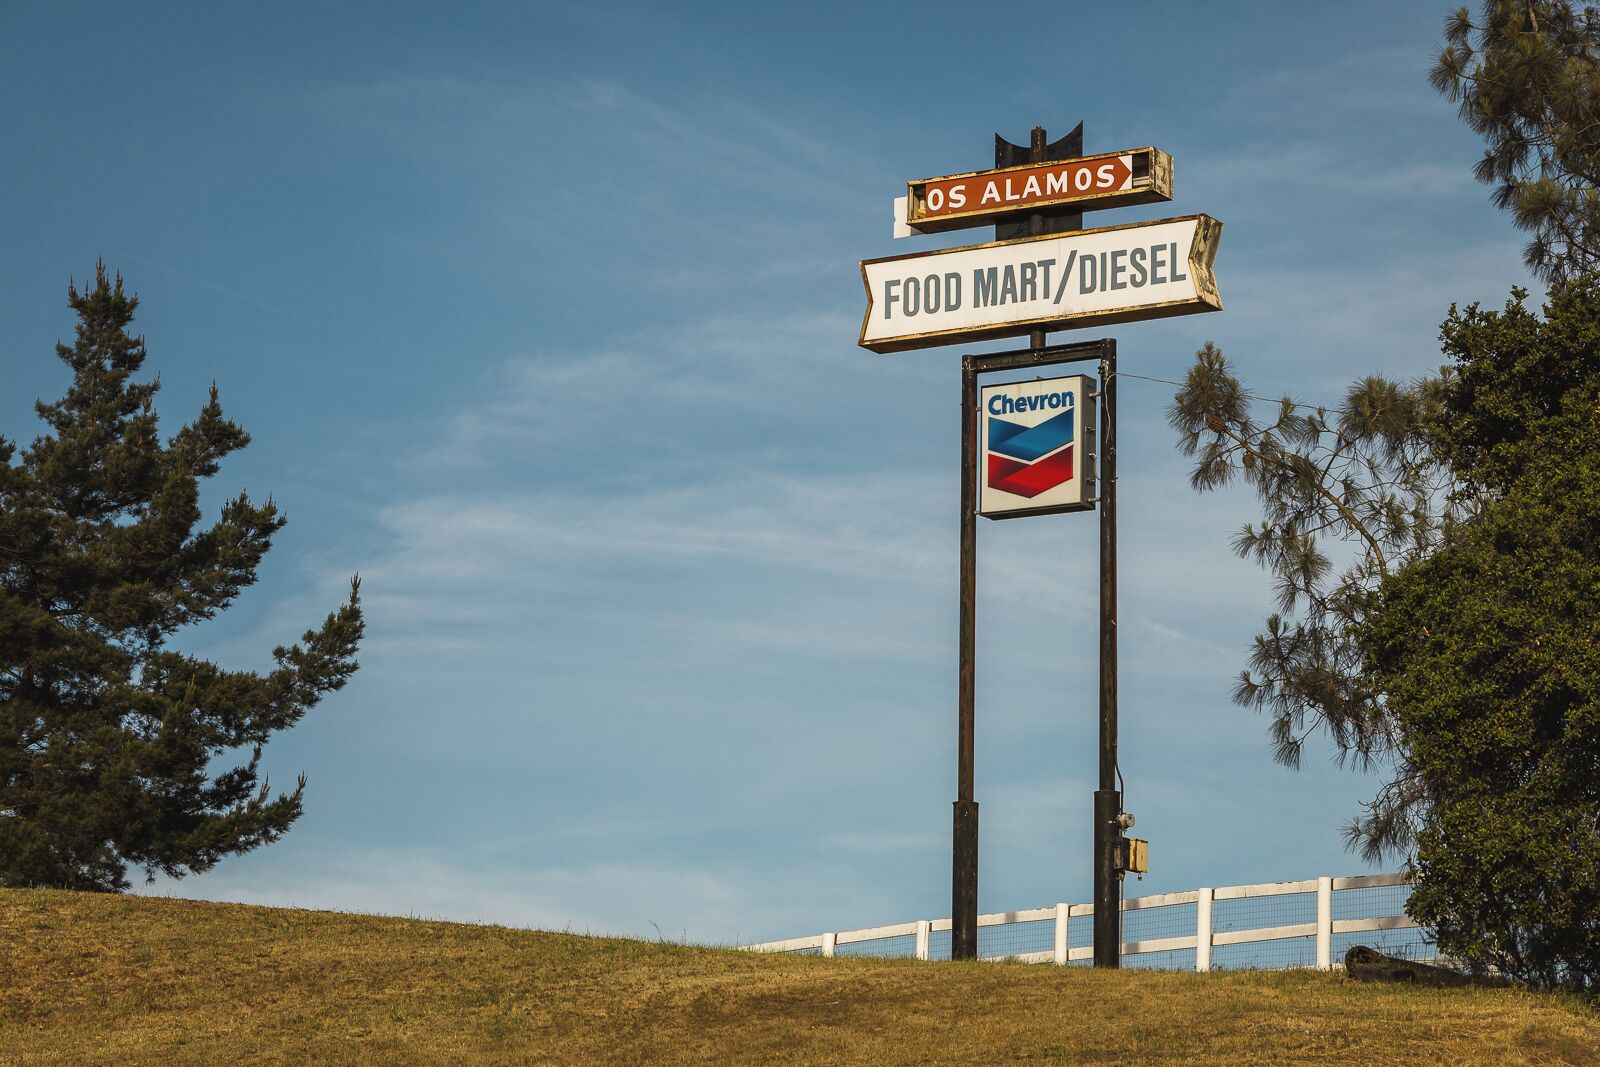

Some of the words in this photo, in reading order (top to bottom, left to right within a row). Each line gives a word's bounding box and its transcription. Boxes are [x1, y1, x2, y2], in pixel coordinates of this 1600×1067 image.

[980, 164, 1116, 205] ALAMOS
[884, 271, 962, 320] FOOD
[973, 242, 1187, 308] MART/DIESEL
[988, 390, 1075, 416] Chevron
